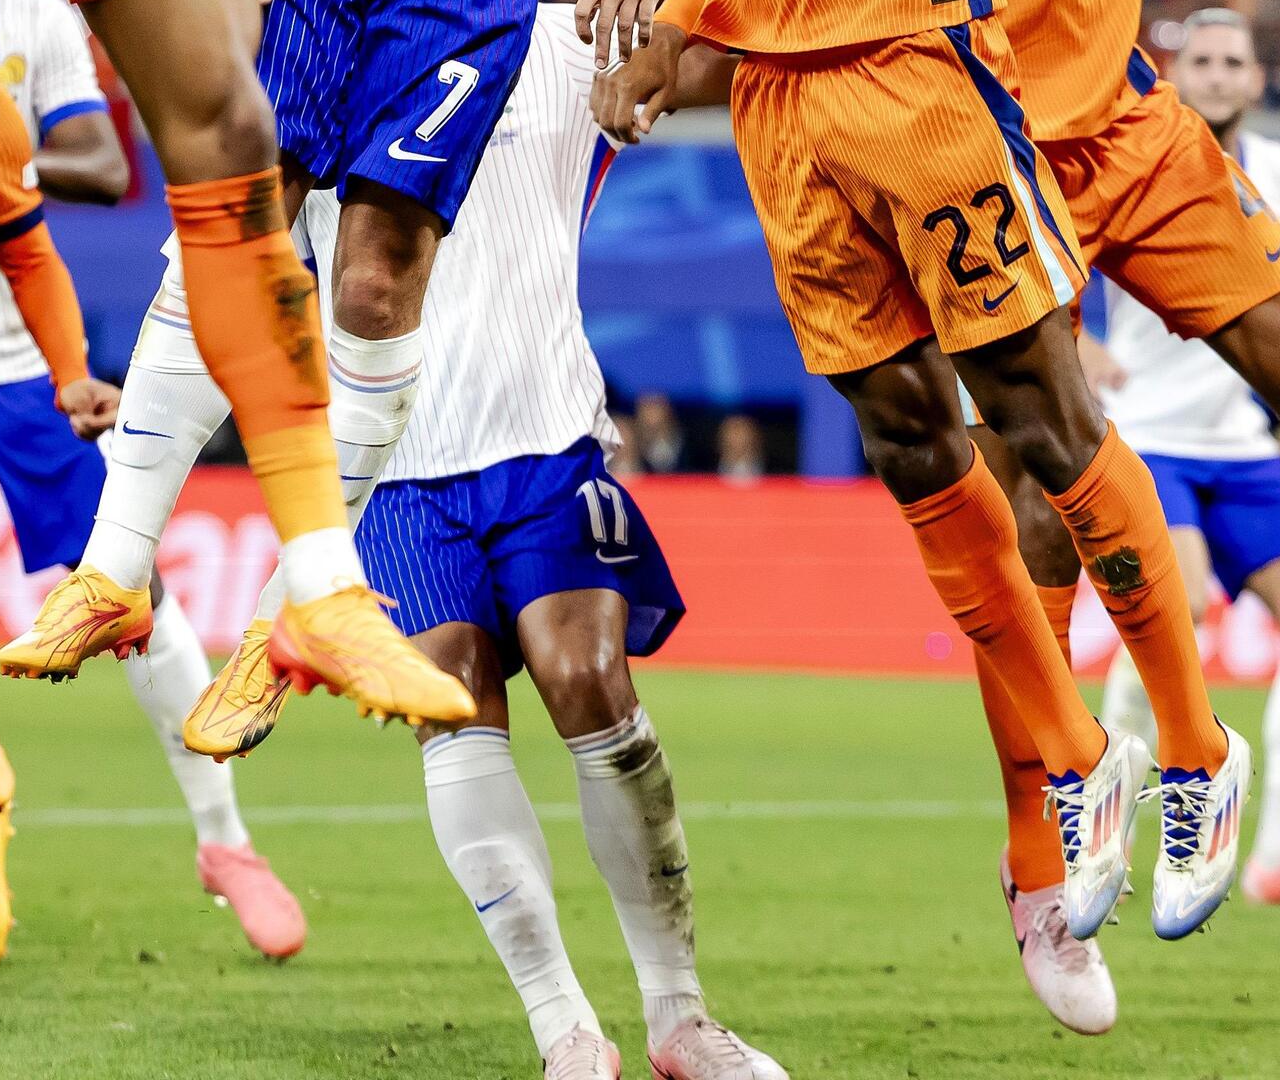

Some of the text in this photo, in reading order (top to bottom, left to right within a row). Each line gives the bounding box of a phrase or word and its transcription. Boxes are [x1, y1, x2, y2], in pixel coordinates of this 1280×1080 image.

[415, 59, 480, 142] 7
[921, 182, 1031, 289] 22
[576, 477, 628, 546] 17
